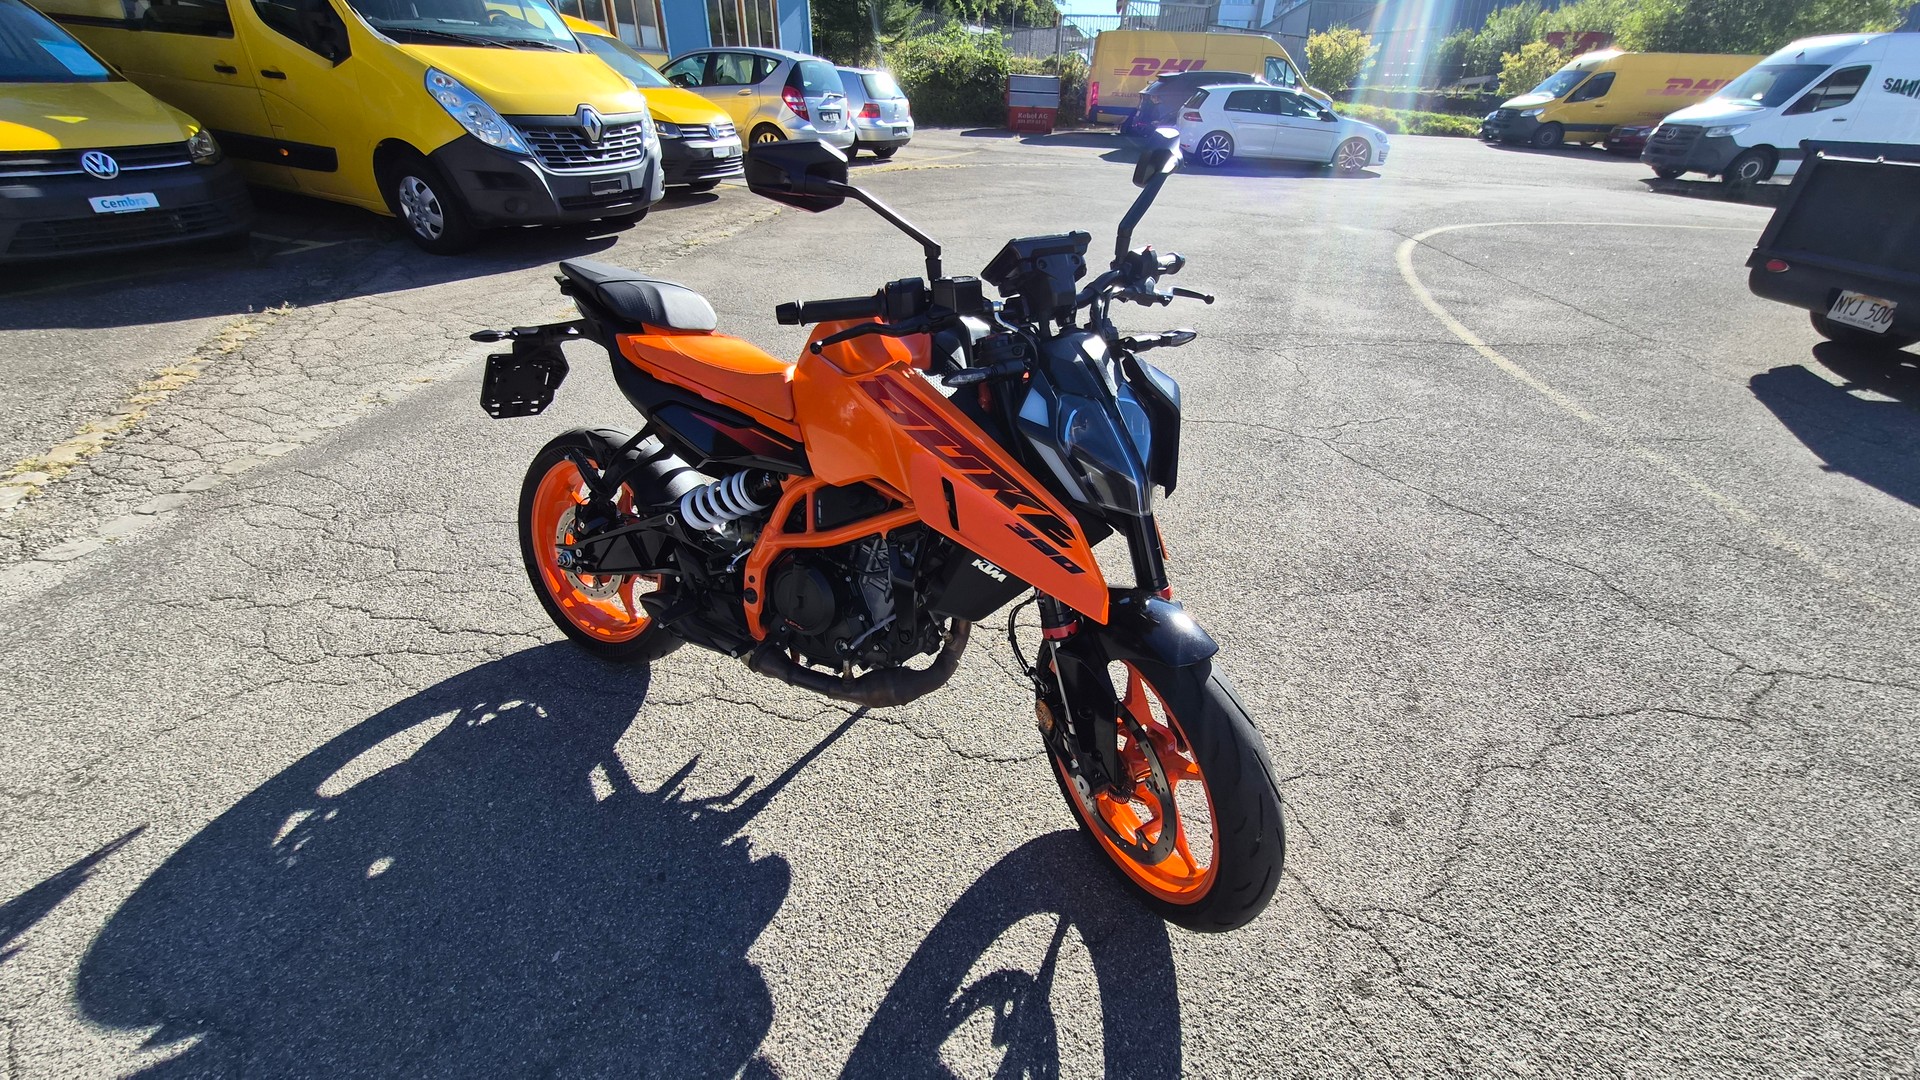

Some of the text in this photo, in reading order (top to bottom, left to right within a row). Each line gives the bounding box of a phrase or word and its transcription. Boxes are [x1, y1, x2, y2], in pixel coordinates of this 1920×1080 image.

[1661, 78, 1735, 96] DH
[100, 196, 149, 209] Cembra
[1833, 295, 1895, 325] NYJ 500
[856, 374, 1077, 549] DUKE
[1004, 522, 1086, 575] 390
[971, 558, 1007, 583] KTM
